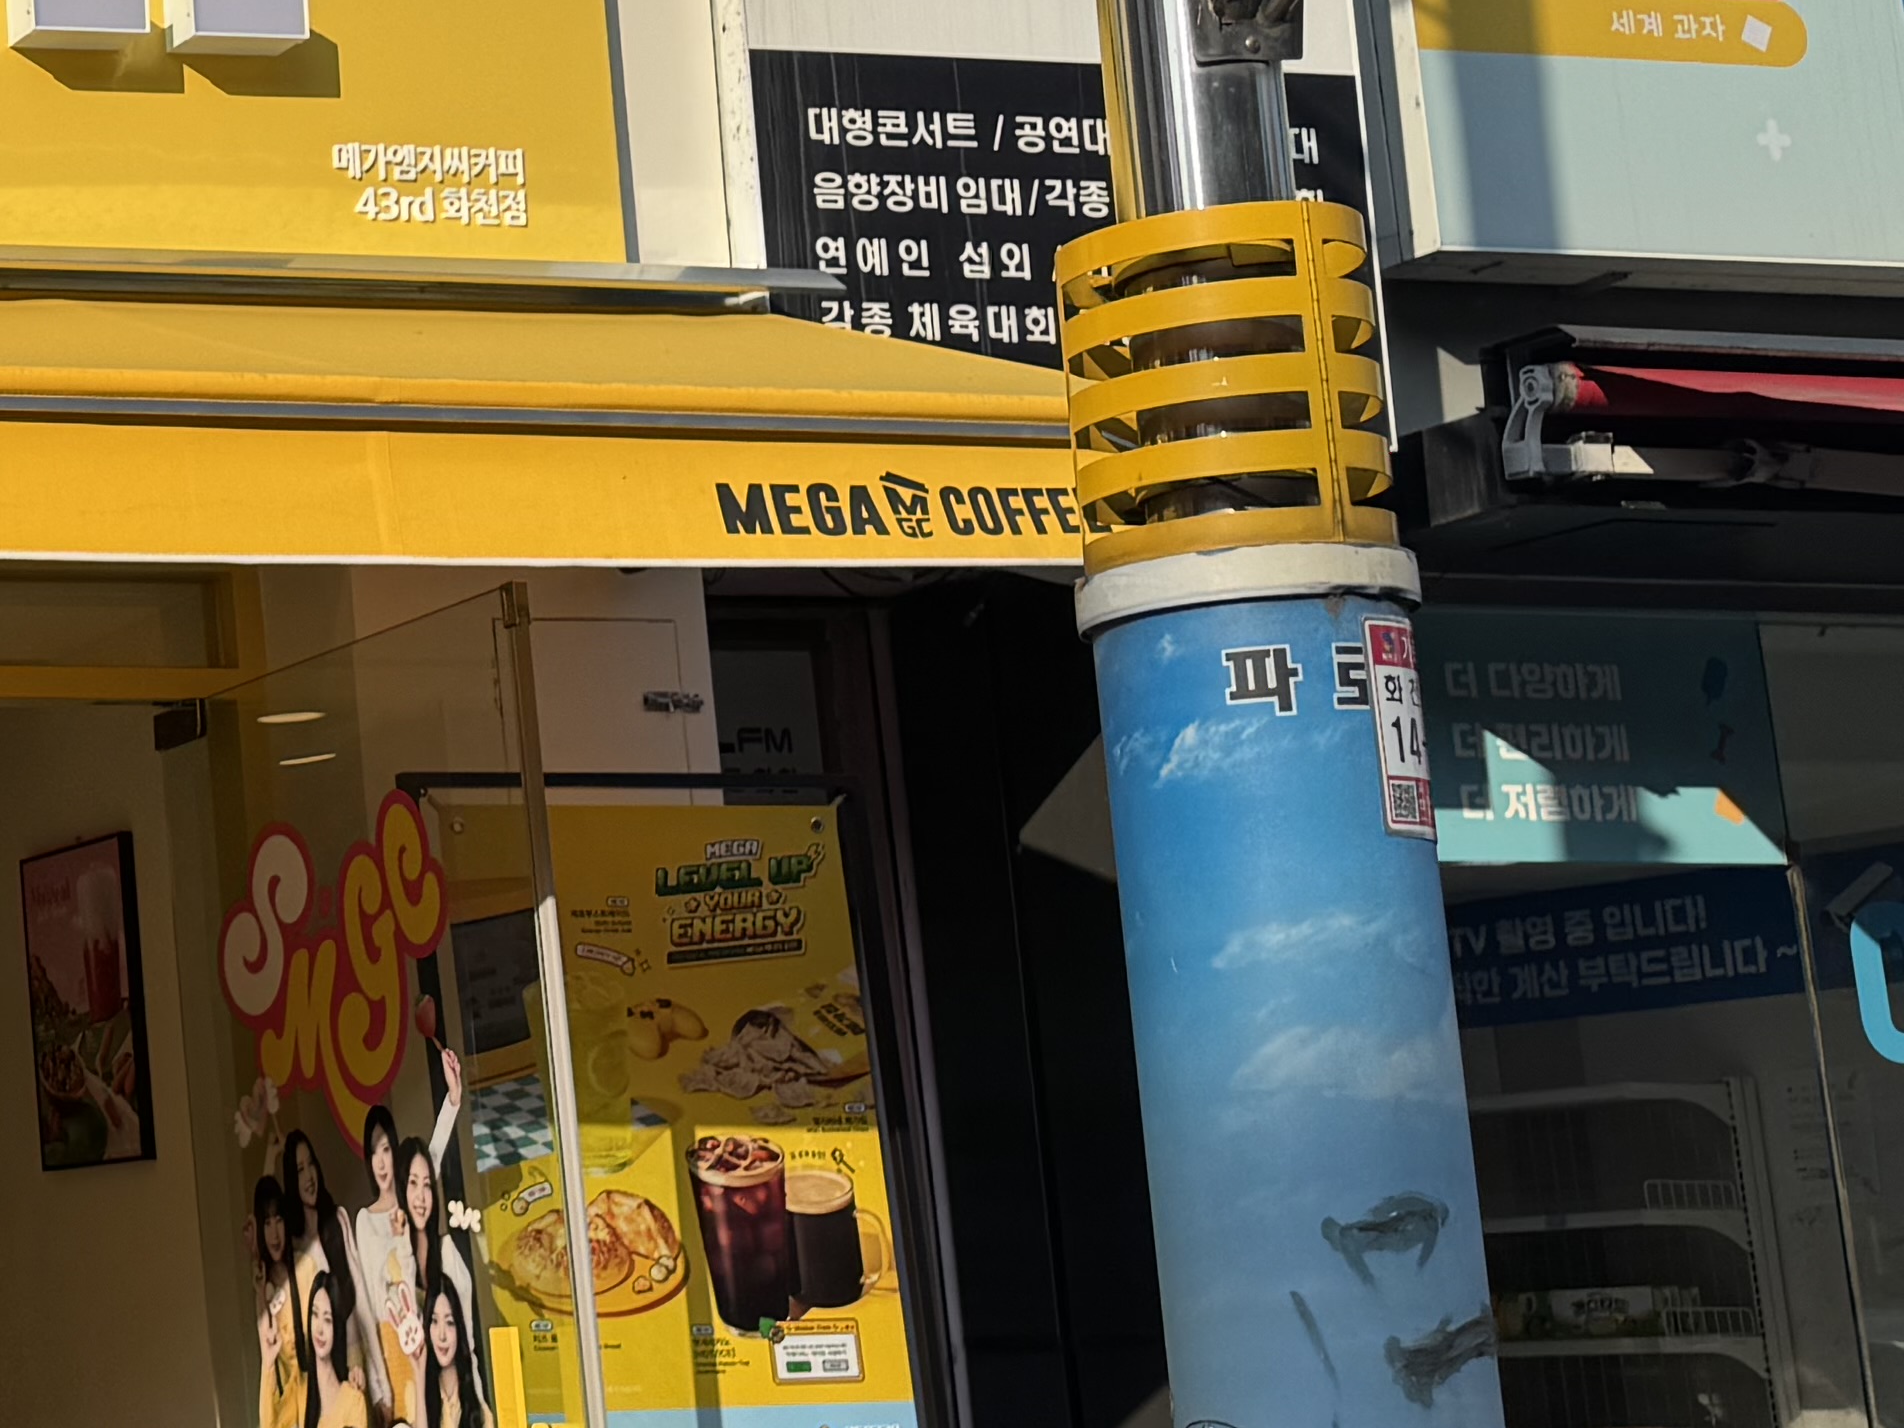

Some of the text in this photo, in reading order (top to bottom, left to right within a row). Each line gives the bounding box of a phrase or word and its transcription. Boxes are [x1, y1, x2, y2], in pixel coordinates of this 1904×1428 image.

[1610, 9, 1726, 43] 세계 과자
[807, 107, 979, 150] 대형콘서트
[331, 141, 526, 186] 메가엠지씨커피
[353, 186, 529, 228] 43rd 화천점
[812, 171, 1111, 219] 음향장비 임대/각종
[814, 236, 1033, 282] 연예인 섭외
[907, 302, 1057, 345] 체육대회
[715, 482, 891, 537] MEGA
[1443, 661, 1623, 703] 더 다양하게
[1452, 723, 1631, 763] 더 편리하게
[1460, 784, 1495, 822] 더
[1500, 782, 1639, 823] 저렴하게
[705, 839, 761, 860] MEGA
[655, 853, 816, 897] LEVEL UP
[703, 888, 763, 912] YOUR
[670, 907, 804, 947] ENERGY
[1495, 912, 1556, 955] 촬영
[1563, 908, 1596, 947] 중
[1507, 958, 1570, 1001] 계산
[1577, 935, 1768, 993] 부탁드립니다
